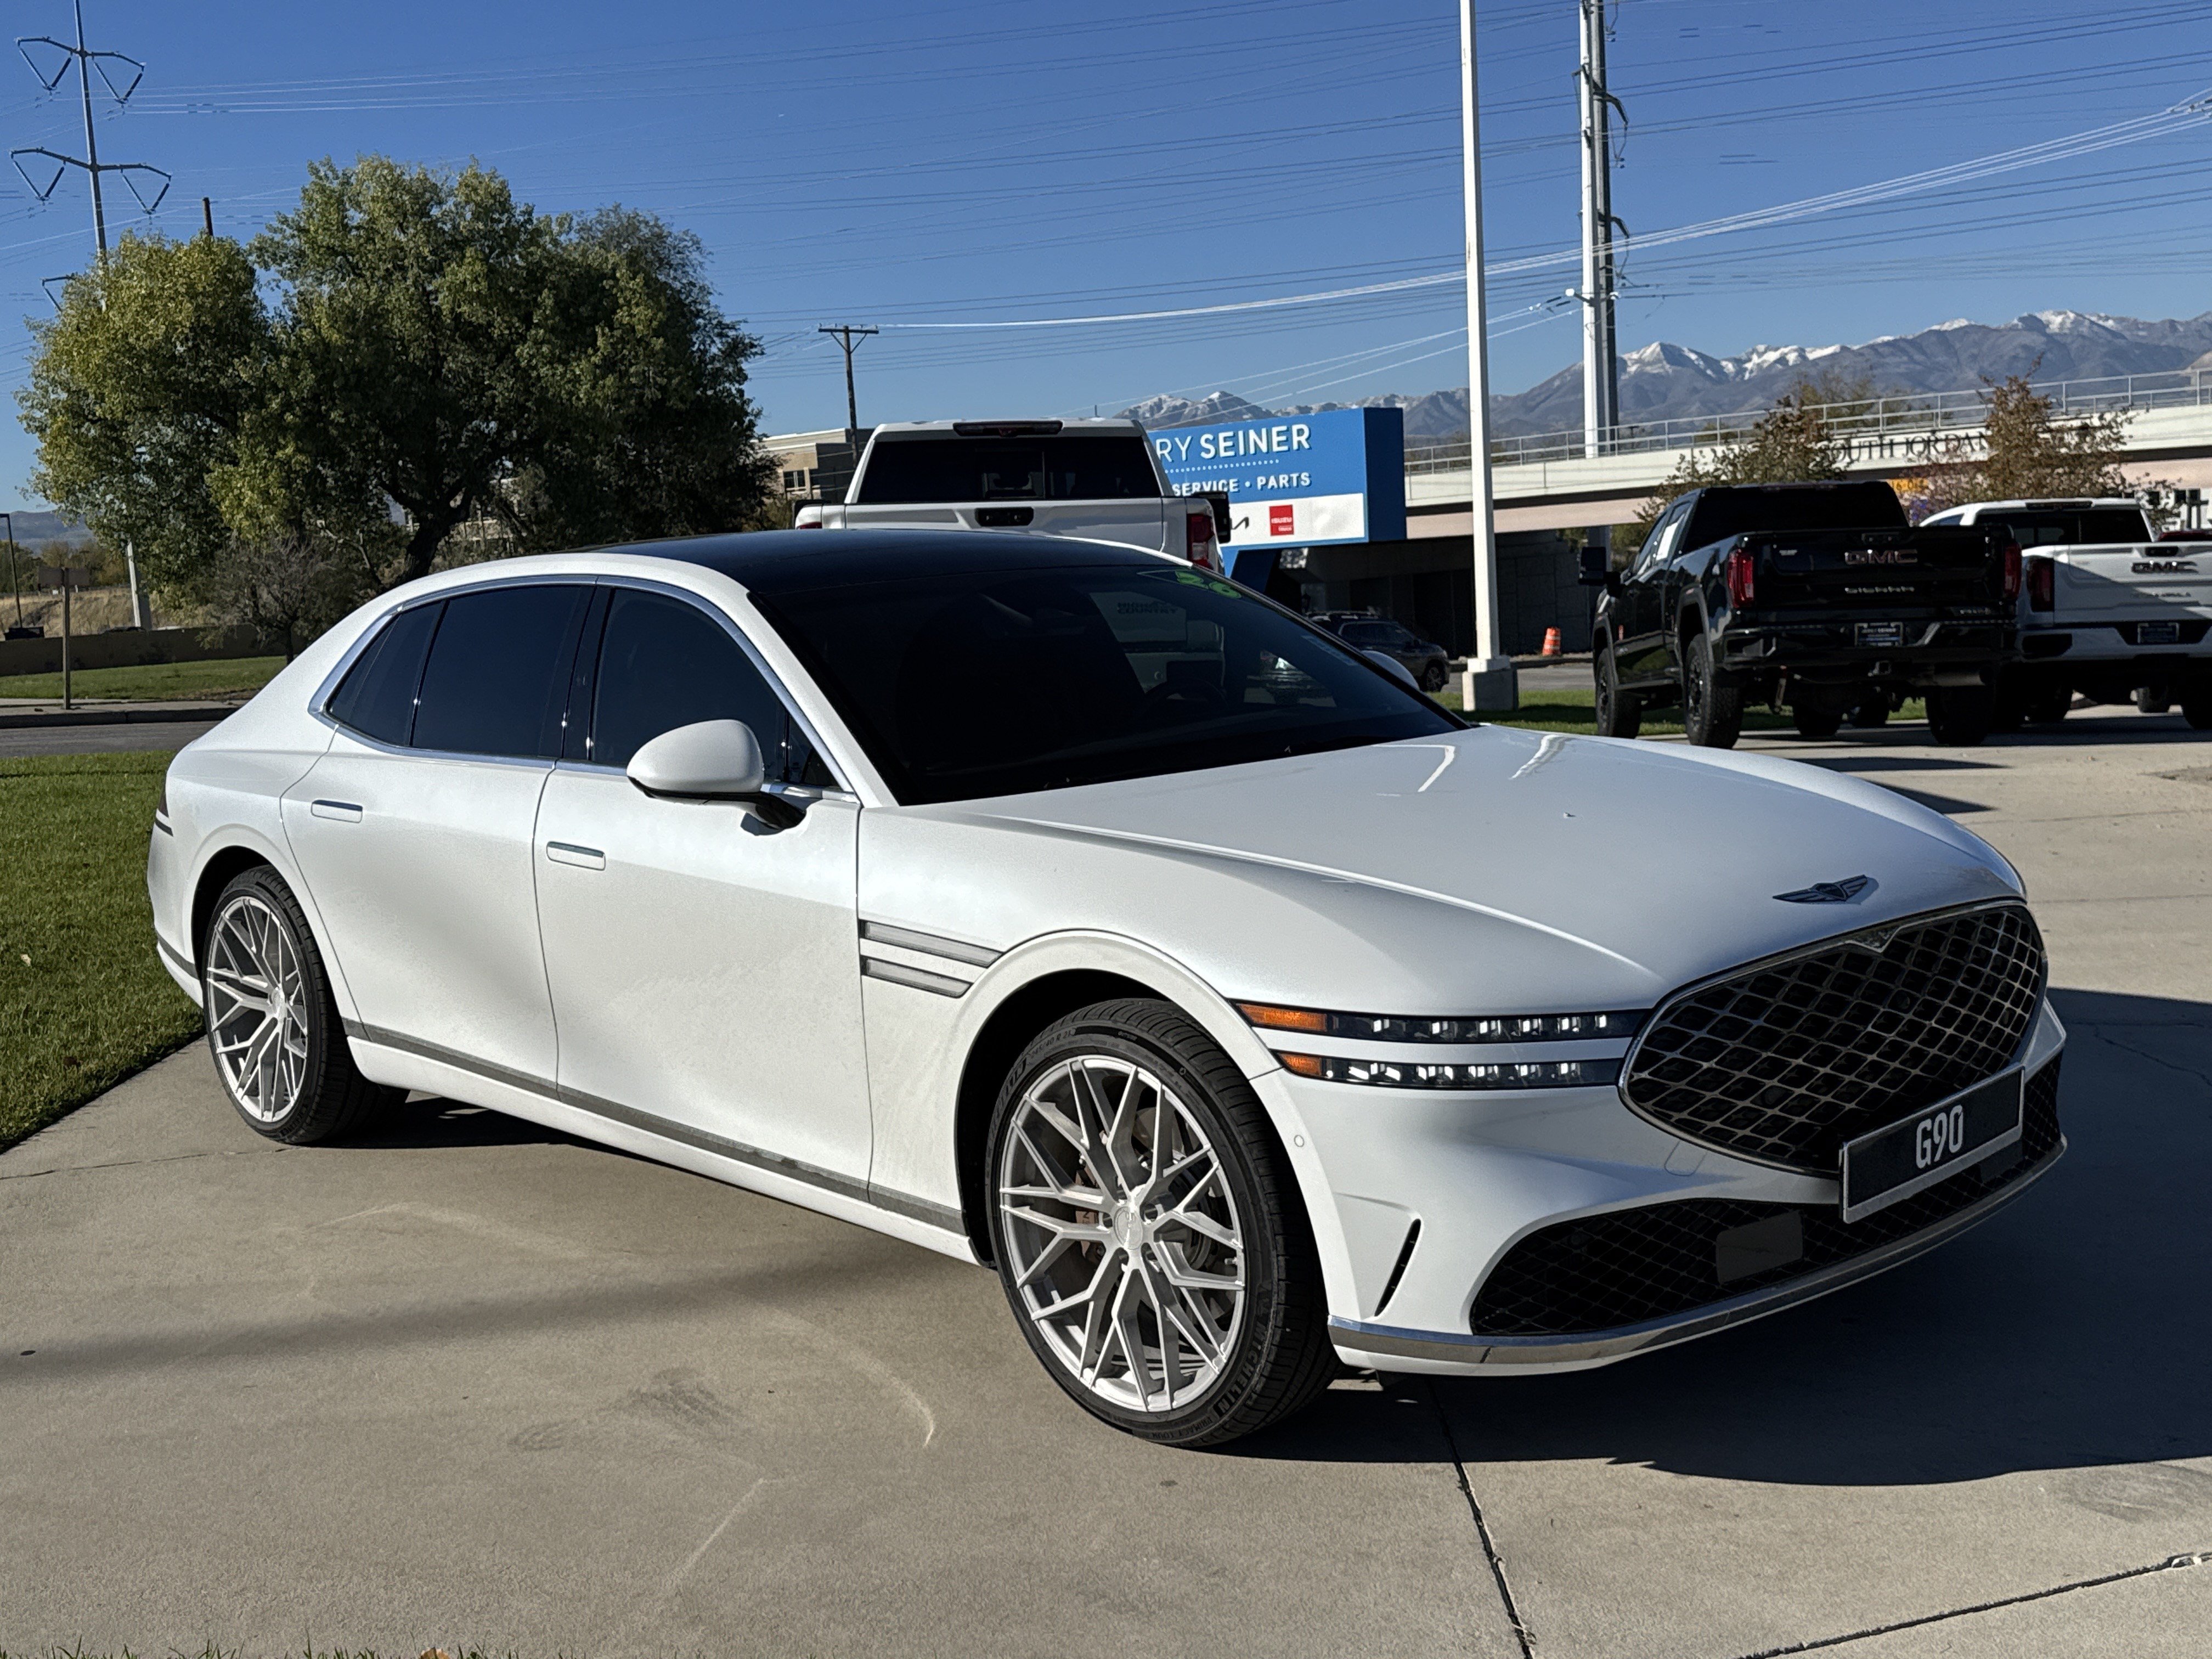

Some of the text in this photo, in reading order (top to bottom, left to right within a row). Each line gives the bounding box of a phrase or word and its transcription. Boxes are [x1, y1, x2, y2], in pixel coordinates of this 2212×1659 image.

[1200, 424, 1311, 459] SEINER
[1172, 472, 1311, 496] SERVICE PARTS
[1844, 549, 1918, 565] GMC
[2132, 561, 2199, 574] GMC
[1915, 1104, 1963, 1169] G90
[1214, 1319, 1268, 1418] MICHELIN
